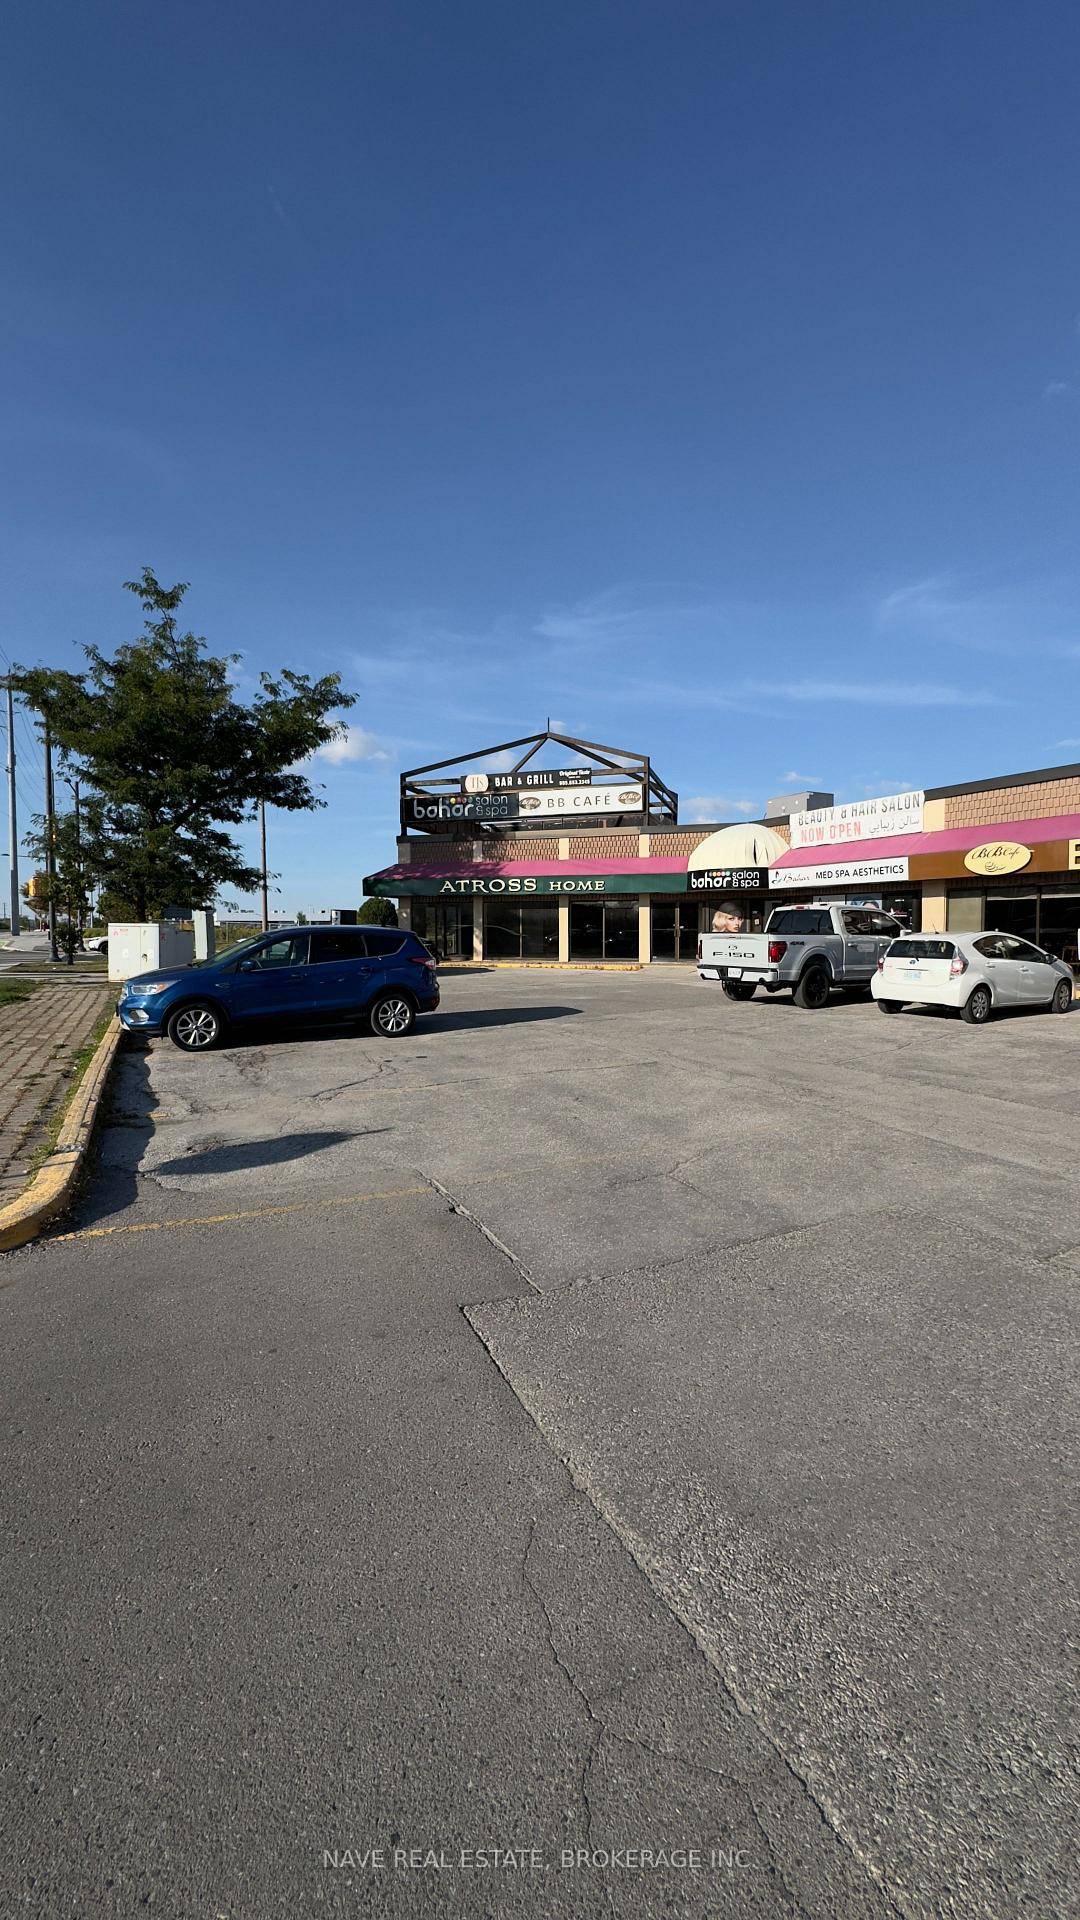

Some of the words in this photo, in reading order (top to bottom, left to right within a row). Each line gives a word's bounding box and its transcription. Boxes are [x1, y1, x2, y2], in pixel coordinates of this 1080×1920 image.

[494, 776, 513, 787] BAR
[517, 777, 522, 785] &
[526, 774, 554, 785] GRILL
[475, 794, 508, 805] salon
[547, 797, 565, 808] BB
[573, 792, 611, 807] CAFÉ
[413, 797, 474, 819] bahar
[476, 805, 483, 816] &
[485, 806, 508, 817] spa
[798, 809, 835, 826] BEAUTY
[851, 802, 877, 818] HAIR
[881, 793, 920, 813] SALON
[800, 825, 825, 843] NOW
[829, 821, 862, 840] OPEN
[732, 870, 760, 879] salon
[815, 871, 833, 880] MED
[835, 868, 851, 878] SPA
[852, 864, 904, 877] AESTHETICS
[439, 878, 537, 893] ATROSS
[549, 880, 605, 891] HOME
[691, 871, 732, 889] bahar
[732, 878, 739, 887] &
[740, 879, 760, 889] spa
[712, 951, 755, 959] F-150
